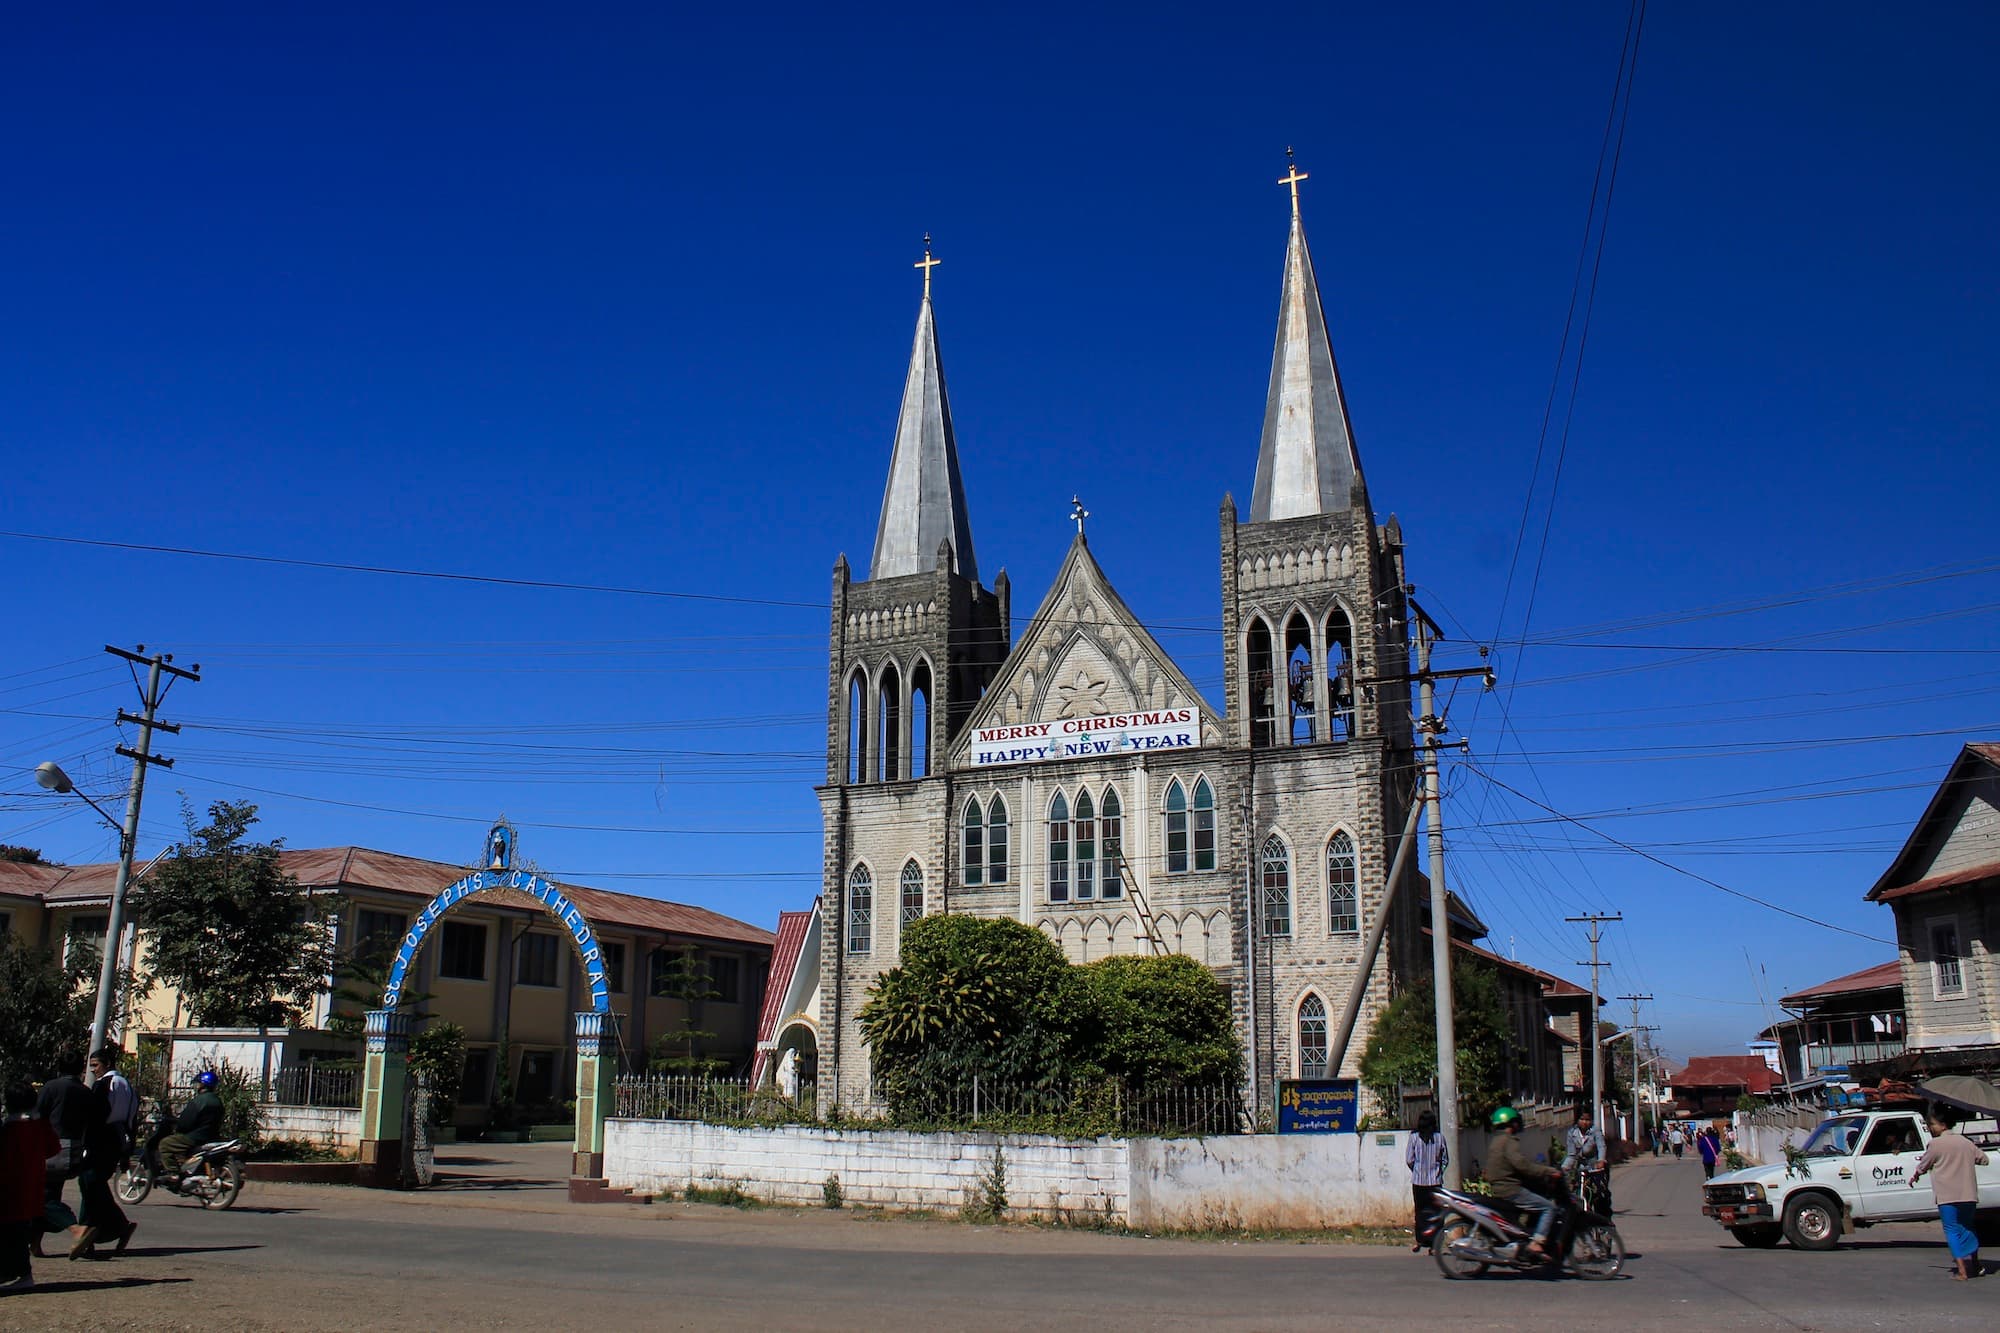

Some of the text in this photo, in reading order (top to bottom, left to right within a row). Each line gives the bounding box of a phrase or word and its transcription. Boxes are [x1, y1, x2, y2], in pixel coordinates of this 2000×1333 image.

[979, 709, 1192, 742] MERRY CHRISTMAS
[1080, 732, 1091, 742] &
[978, 733, 1192, 764] HAPPY NEW YEAR
[511, 869, 607, 1007] CATHEDRAL
[1876, 1179, 1906, 1187] Lubricants
[1884, 1166, 1904, 1179] ptt
